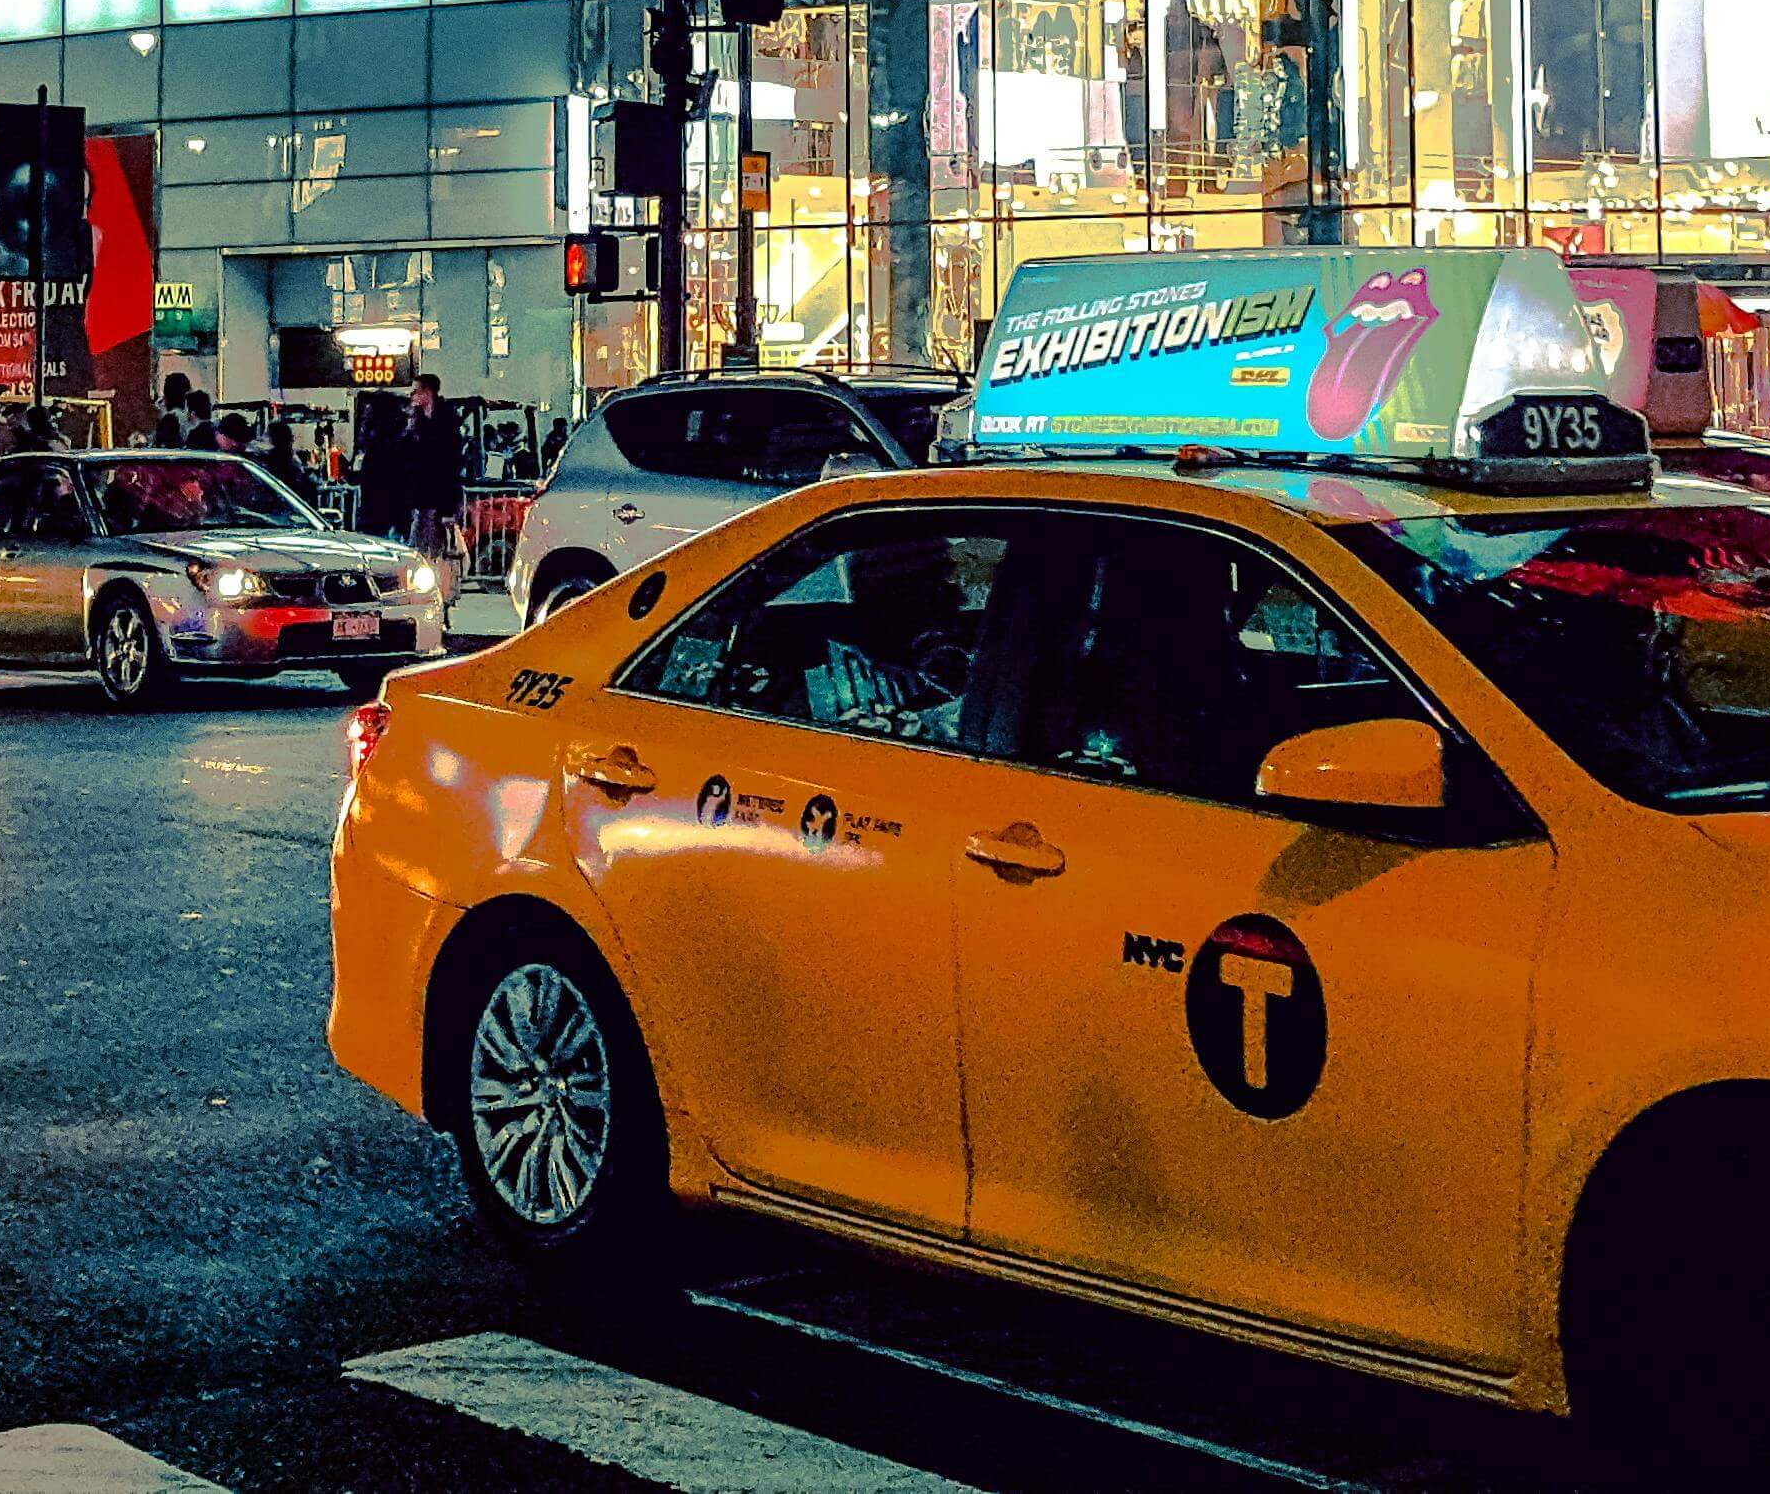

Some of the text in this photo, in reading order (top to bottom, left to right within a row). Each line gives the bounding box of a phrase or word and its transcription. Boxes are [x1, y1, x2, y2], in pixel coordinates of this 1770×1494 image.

[11, 273, 88, 308] FRDAY
[1006, 280, 1208, 334] THE ROLLING STONES
[990, 283, 1316, 388] EXHIBITIONISM
[1523, 406, 1602, 450] 9Y35
[506, 668, 575, 711] 9Y35
[1123, 931, 1186, 974] NYC
[1219, 952, 1294, 1090] T
